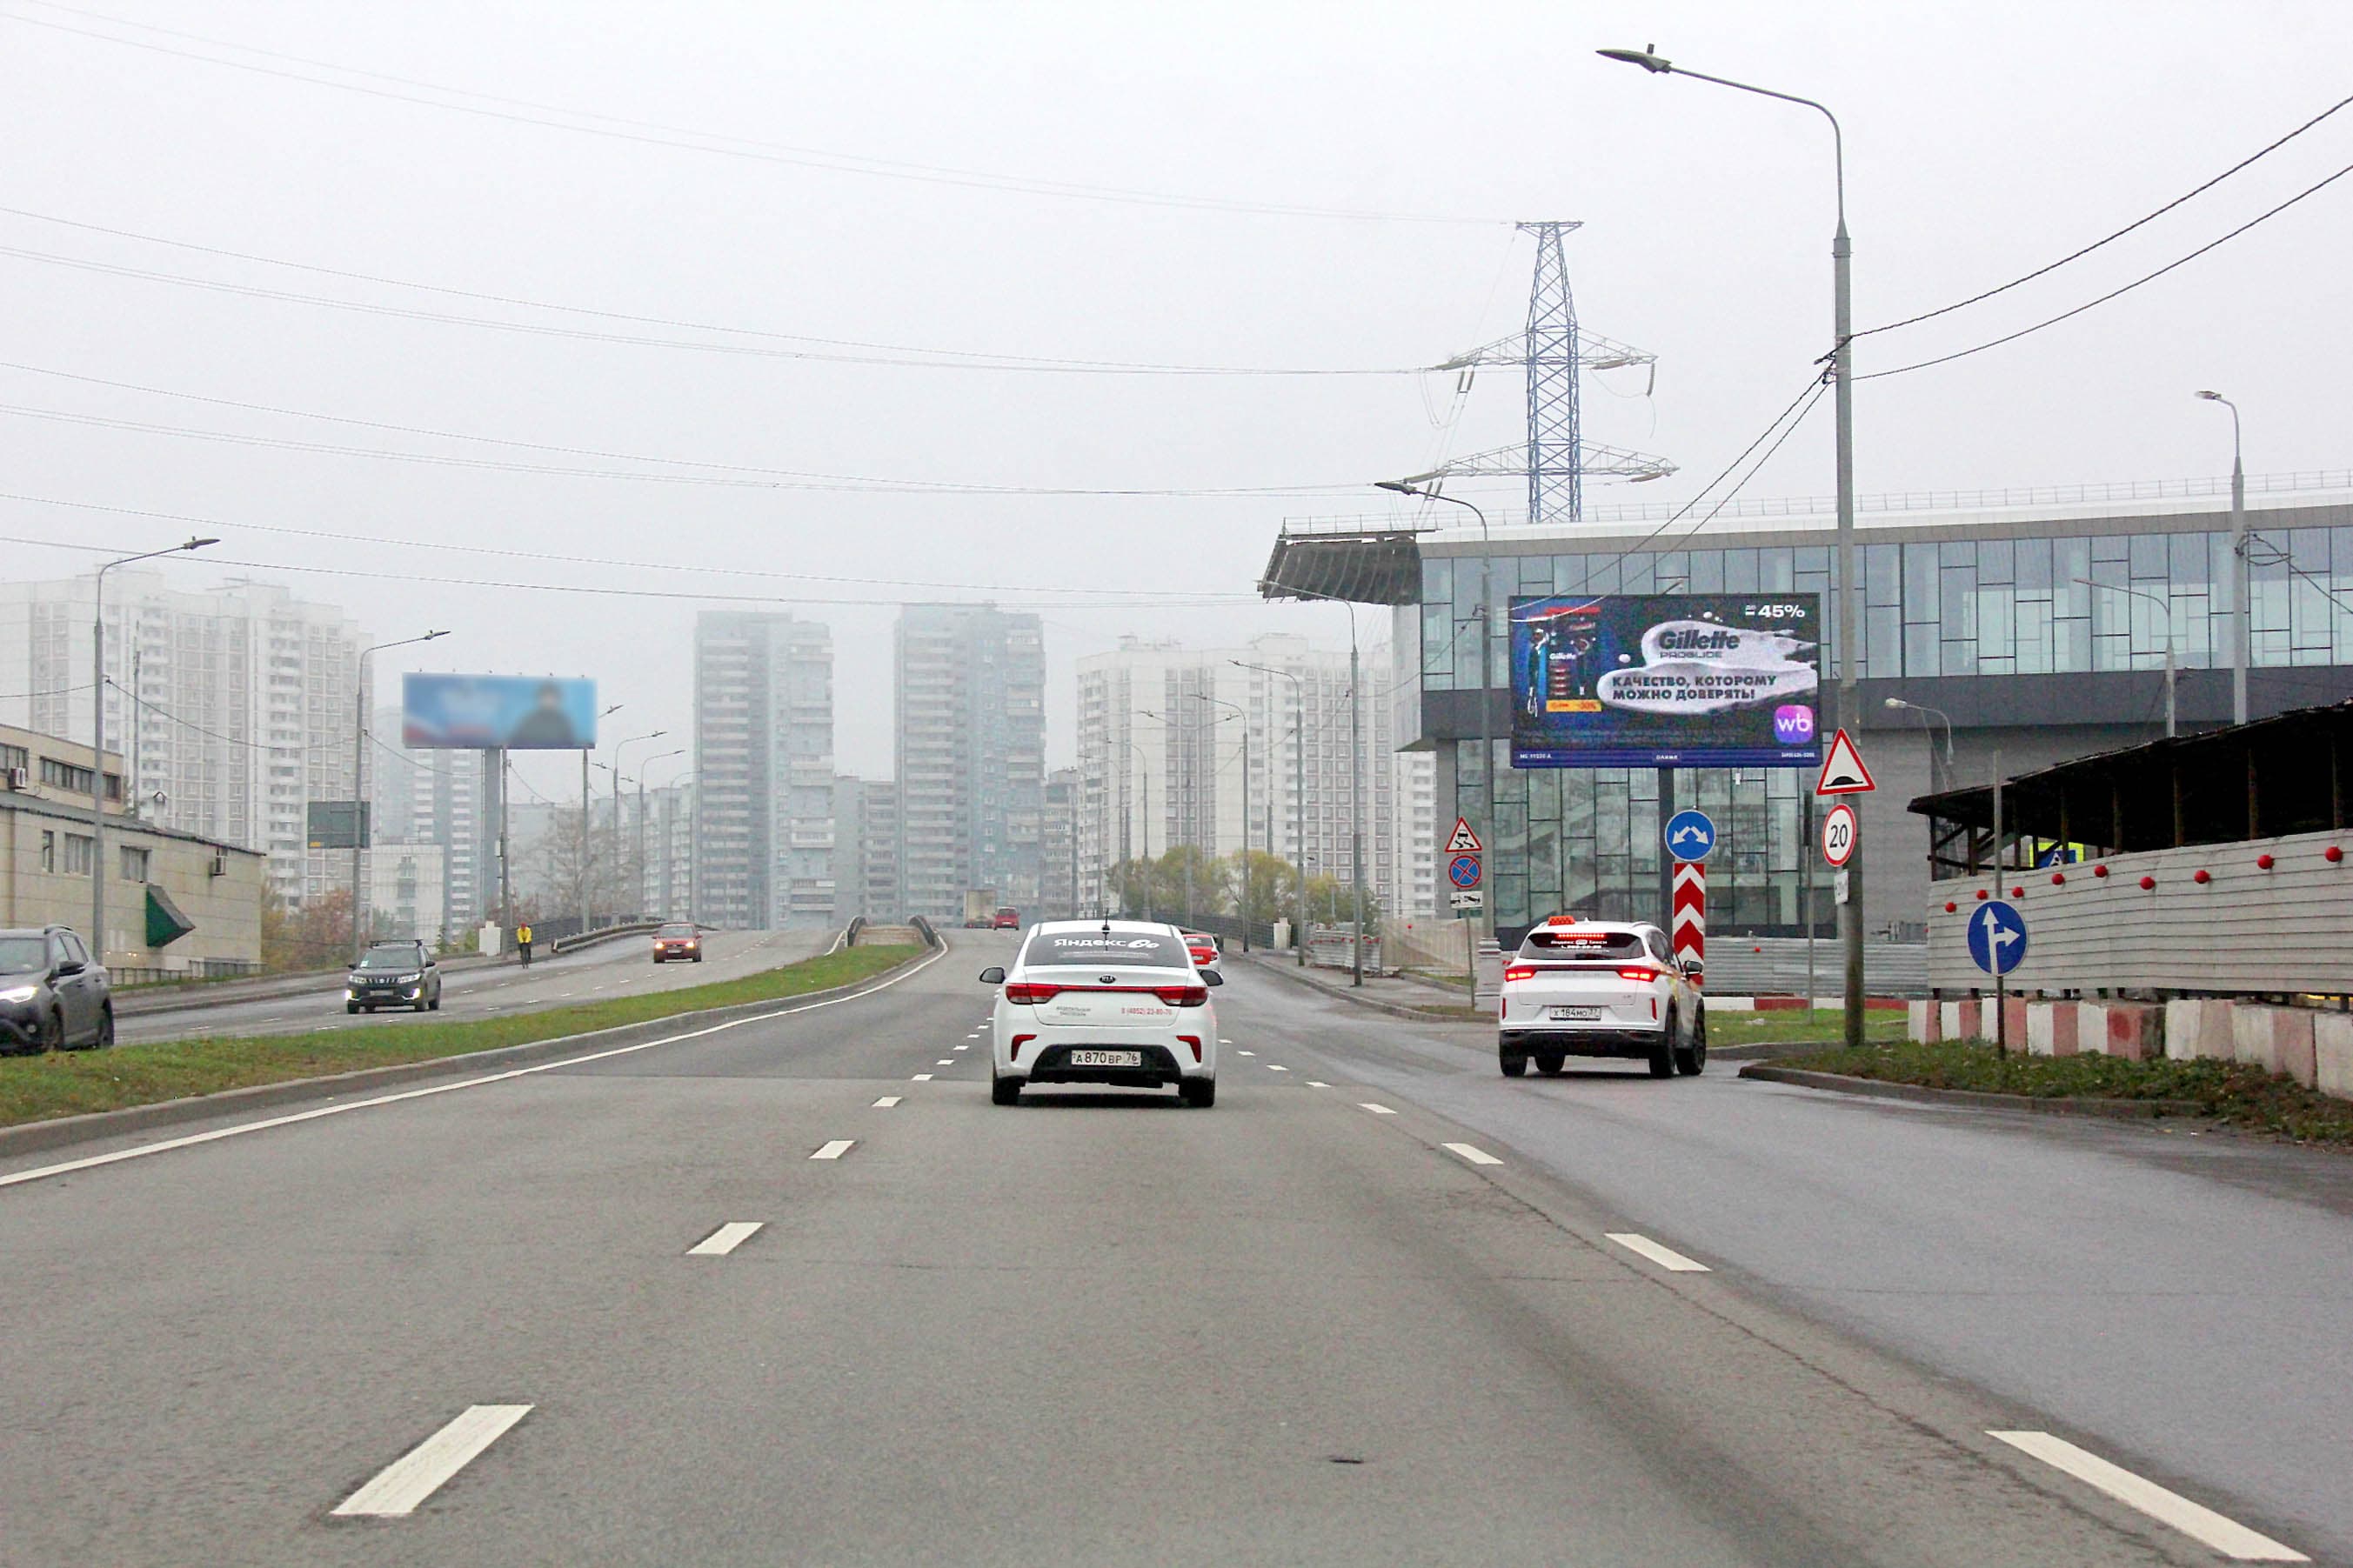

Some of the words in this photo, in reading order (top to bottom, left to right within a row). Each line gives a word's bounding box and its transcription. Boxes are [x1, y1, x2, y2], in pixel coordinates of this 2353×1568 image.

[1659, 629, 1740, 650] Gillette
[1613, 676, 1690, 688] КАЧЕСТВО,
[1695, 676, 1776, 686] КОТОРОМУ
[1613, 690, 1672, 700] МОЖНО
[1675, 689, 1755, 701] ДОВЕРЯТЬ!
[1777, 711, 1810, 732] wb
[1829, 824, 1848, 848] 20
[1127, 939, 1160, 948] Go
